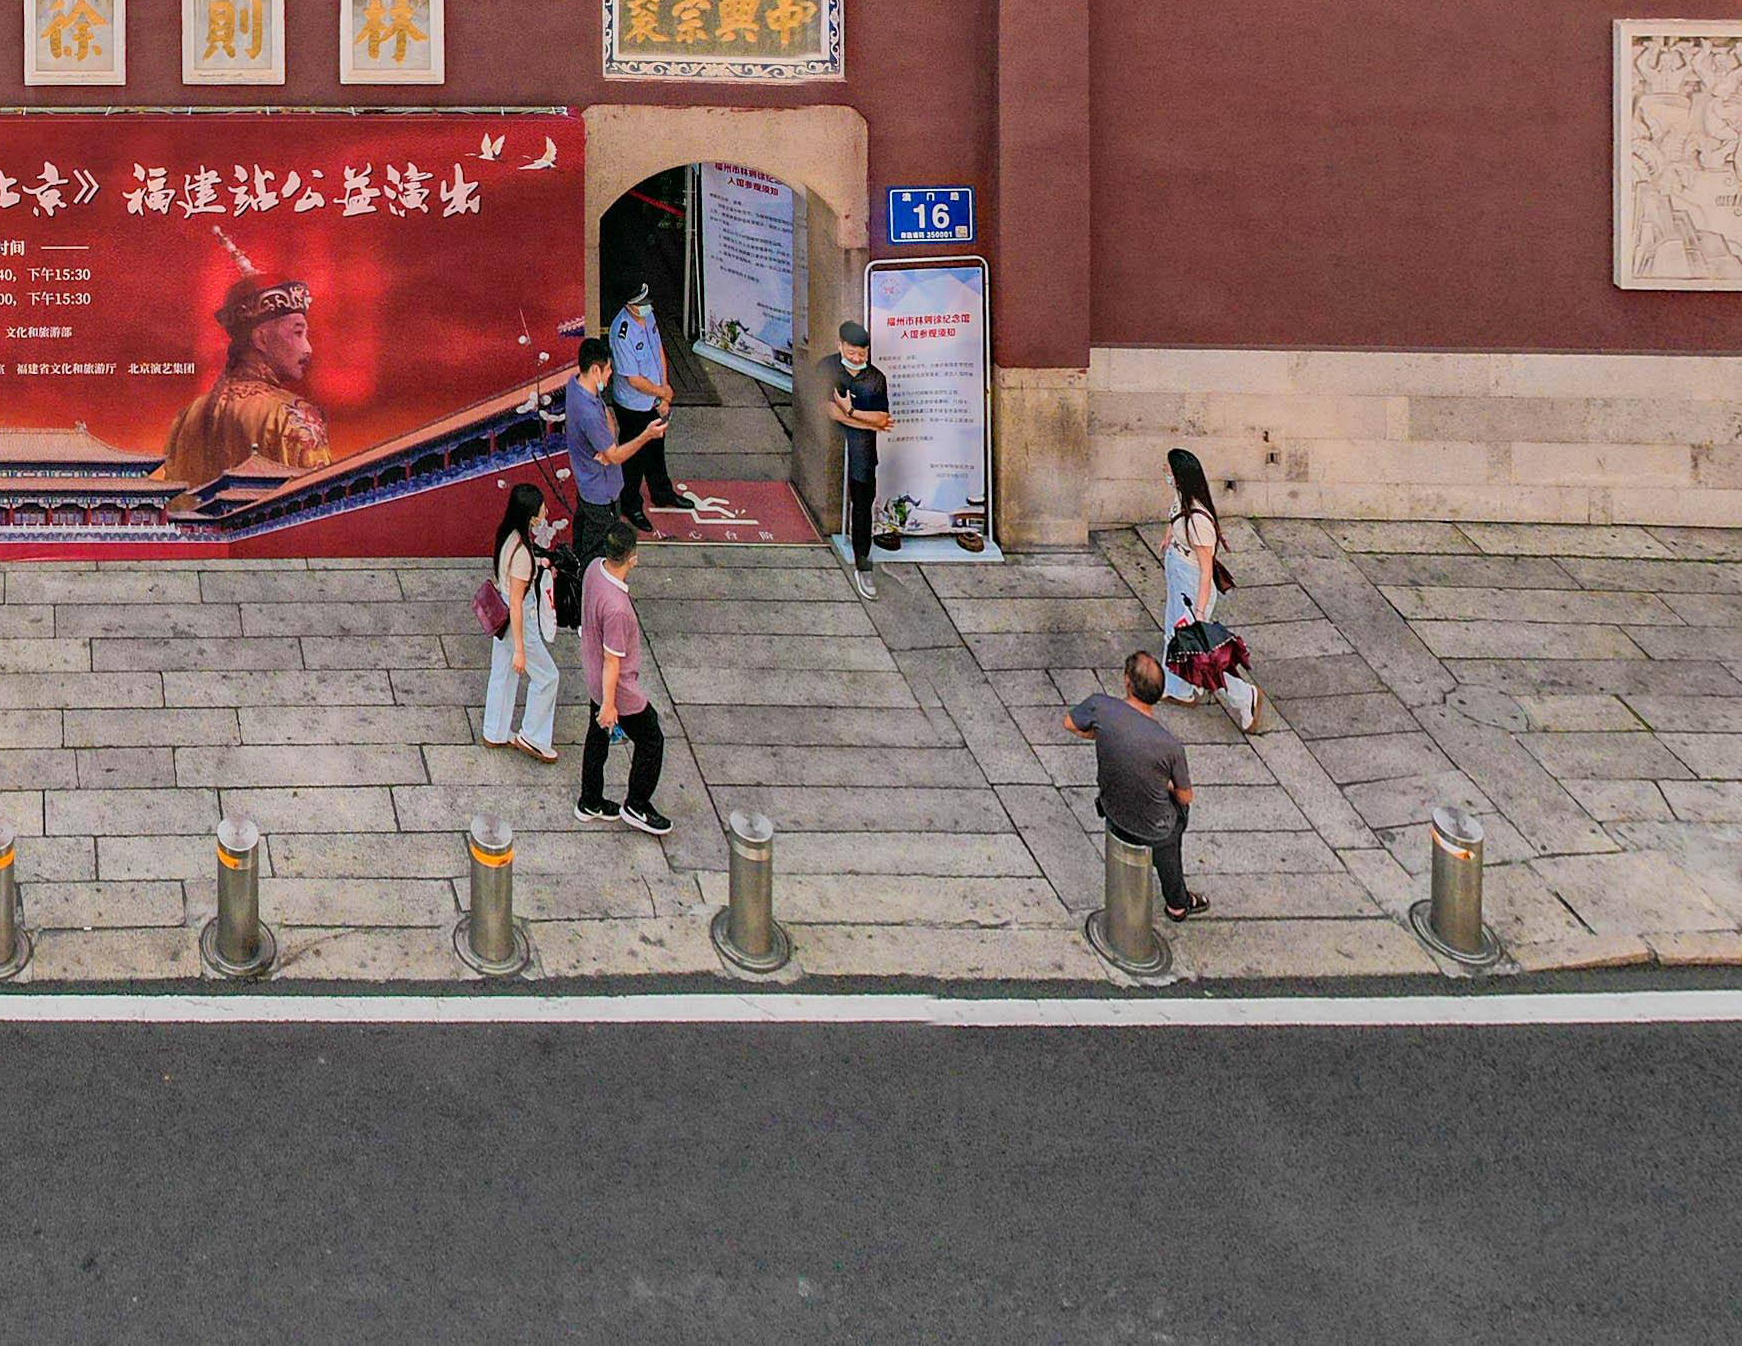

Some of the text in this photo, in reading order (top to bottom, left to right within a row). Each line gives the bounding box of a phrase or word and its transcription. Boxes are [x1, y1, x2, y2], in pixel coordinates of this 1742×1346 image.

[912, 203, 950, 229] 16
[6, 326, 73, 339] 文化和旅游部
[16, 362, 117, 375] 福建省文化和旅游厅
[127, 362, 195, 375] 北京演艺集团
